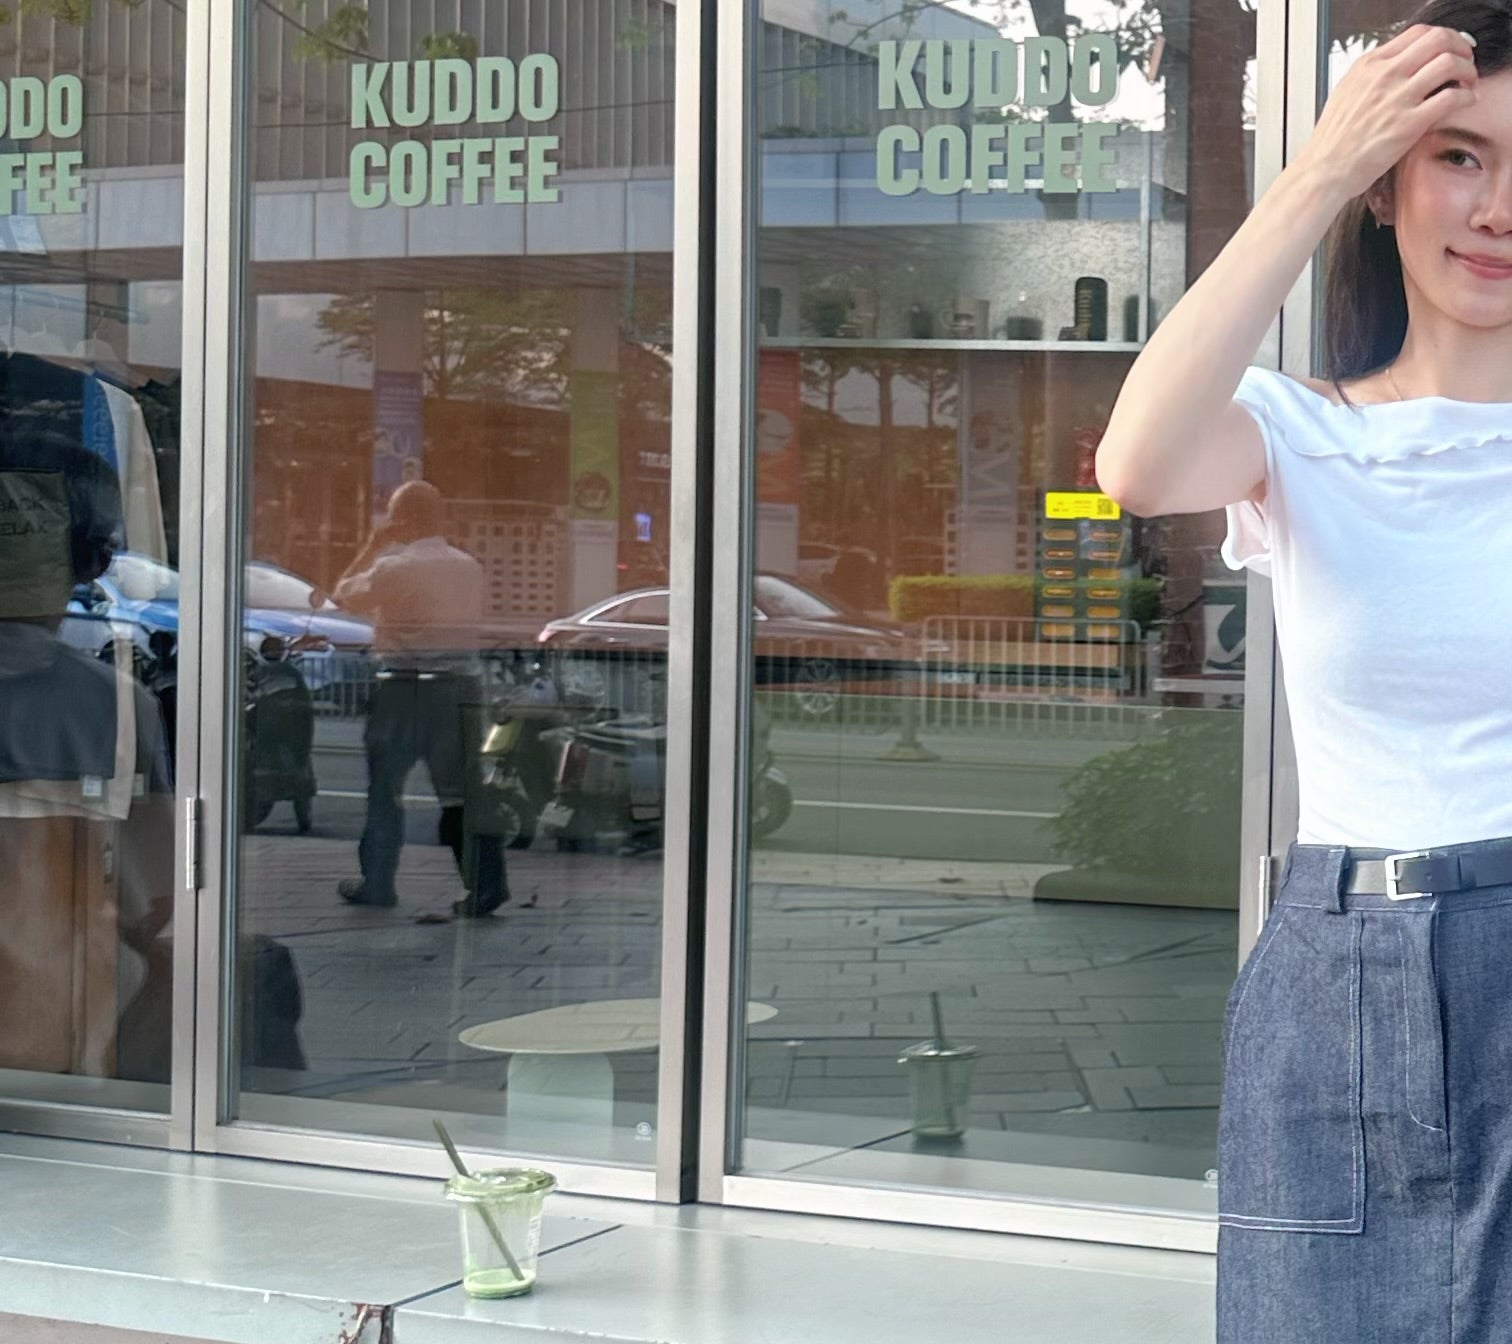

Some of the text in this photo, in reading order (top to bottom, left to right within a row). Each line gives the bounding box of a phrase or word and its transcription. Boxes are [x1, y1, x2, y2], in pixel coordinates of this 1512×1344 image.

[0, 74, 83, 139] DO
[351, 53, 559, 128] KUDDO
[878, 34, 1119, 109] KUDDO
[350, 136, 559, 208] COFFEE
[876, 122, 1119, 195] COFFEE
